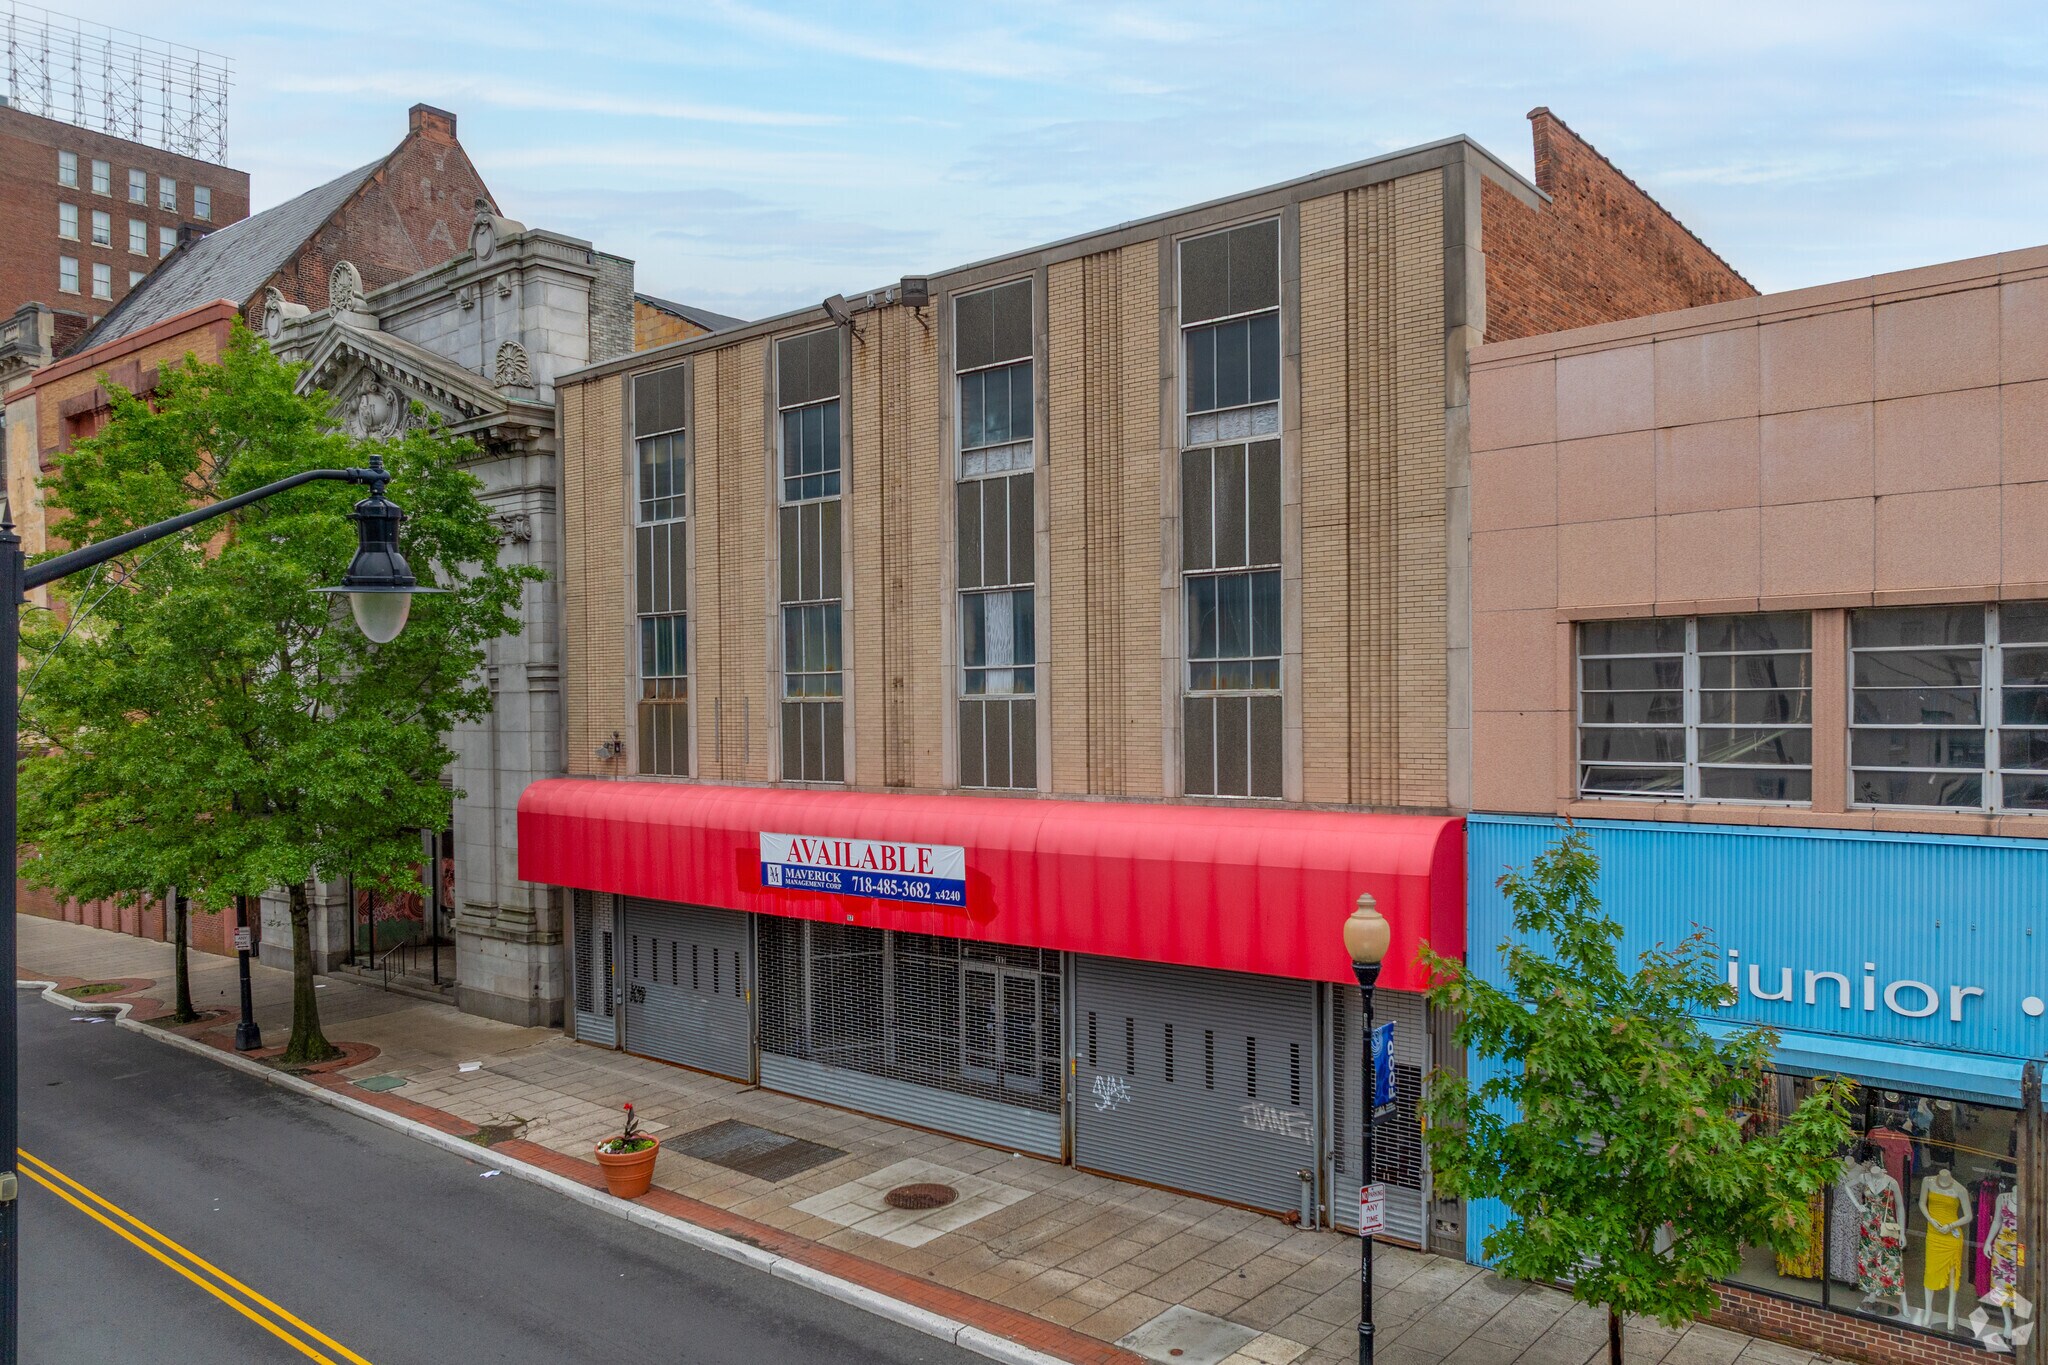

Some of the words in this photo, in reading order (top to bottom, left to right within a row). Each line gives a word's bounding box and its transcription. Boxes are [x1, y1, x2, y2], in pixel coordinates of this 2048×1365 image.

[786, 838, 934, 875] AVAILABLE
[785, 868, 842, 883] MAVERICK
[785, 878, 825, 888] MANAGEMENT
[851, 875, 931, 899] 718-485-3682
[935, 890, 961, 902] x4240
[1719, 949, 1985, 1022] junior
[1387, 1040, 1396, 1099] FOOD
[1366, 1203, 1379, 1213] ANY
[1366, 1214, 1379, 1224] TIME
